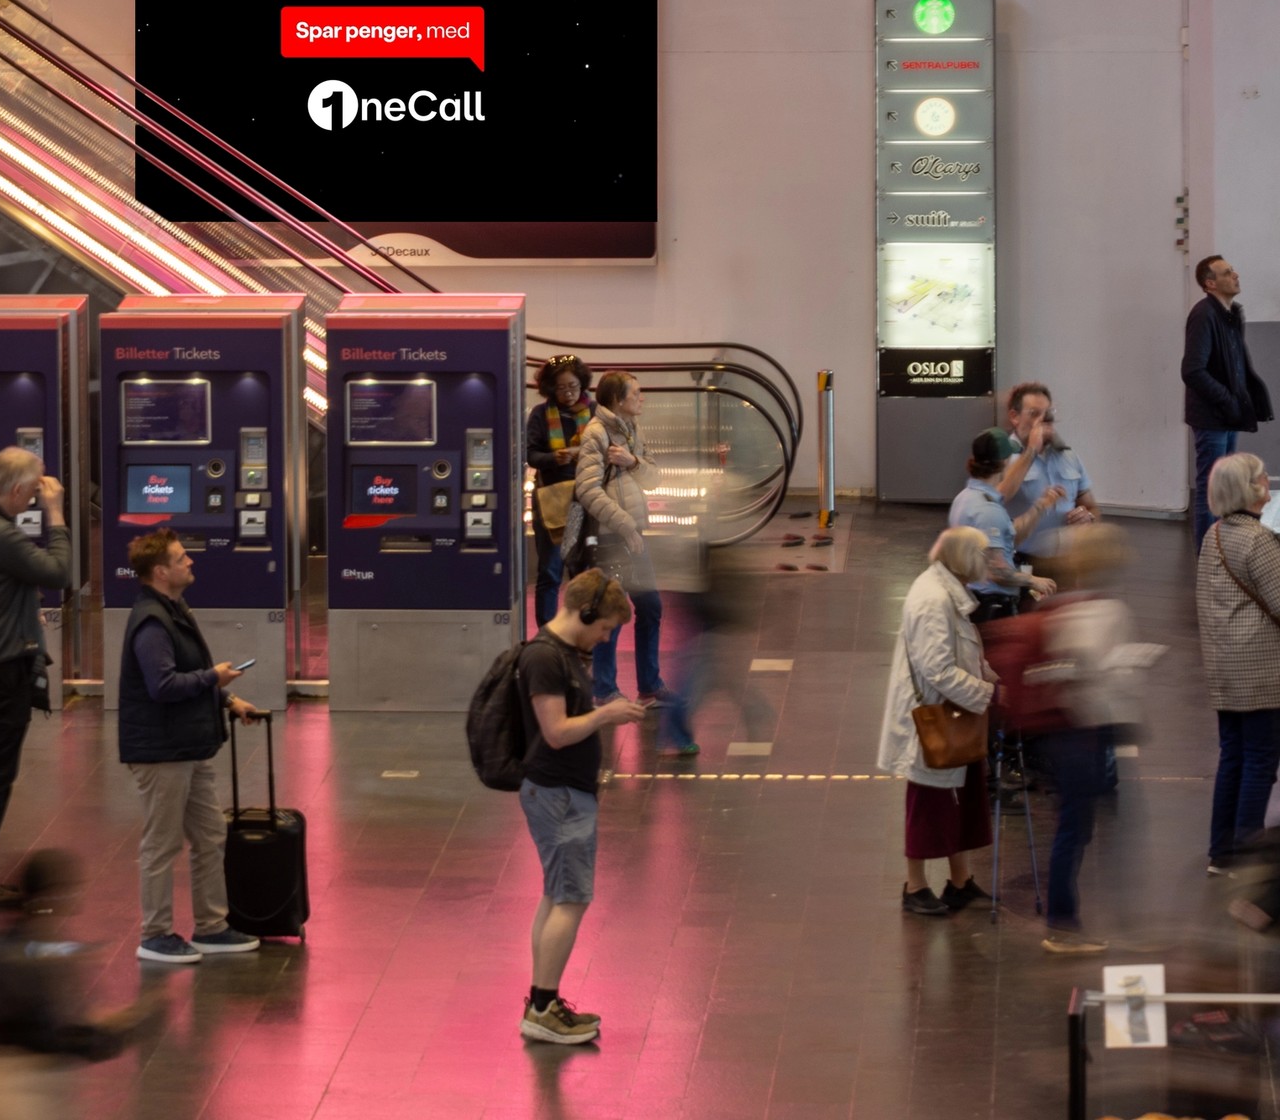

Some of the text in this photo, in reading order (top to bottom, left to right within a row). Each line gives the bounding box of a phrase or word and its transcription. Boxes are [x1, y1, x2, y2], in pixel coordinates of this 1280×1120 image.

[295, 21, 470, 43] Spar penger, med
[904, 210, 950, 227] swift
[115, 347, 221, 360] Billetter Tickets
[340, 348, 448, 361] Billetter Tickets
[906, 361, 950, 376] OSLO
[148, 475, 168, 485] Buy
[373, 476, 394, 486] Buy
[142, 485, 174, 495] tickets
[367, 486, 400, 496] tickets
[146, 495, 169, 504] here
[372, 496, 395, 505] here
[342, 568, 375, 580] ENTUR
[269, 611, 285, 623] 03
[493, 613, 510, 625] 09
